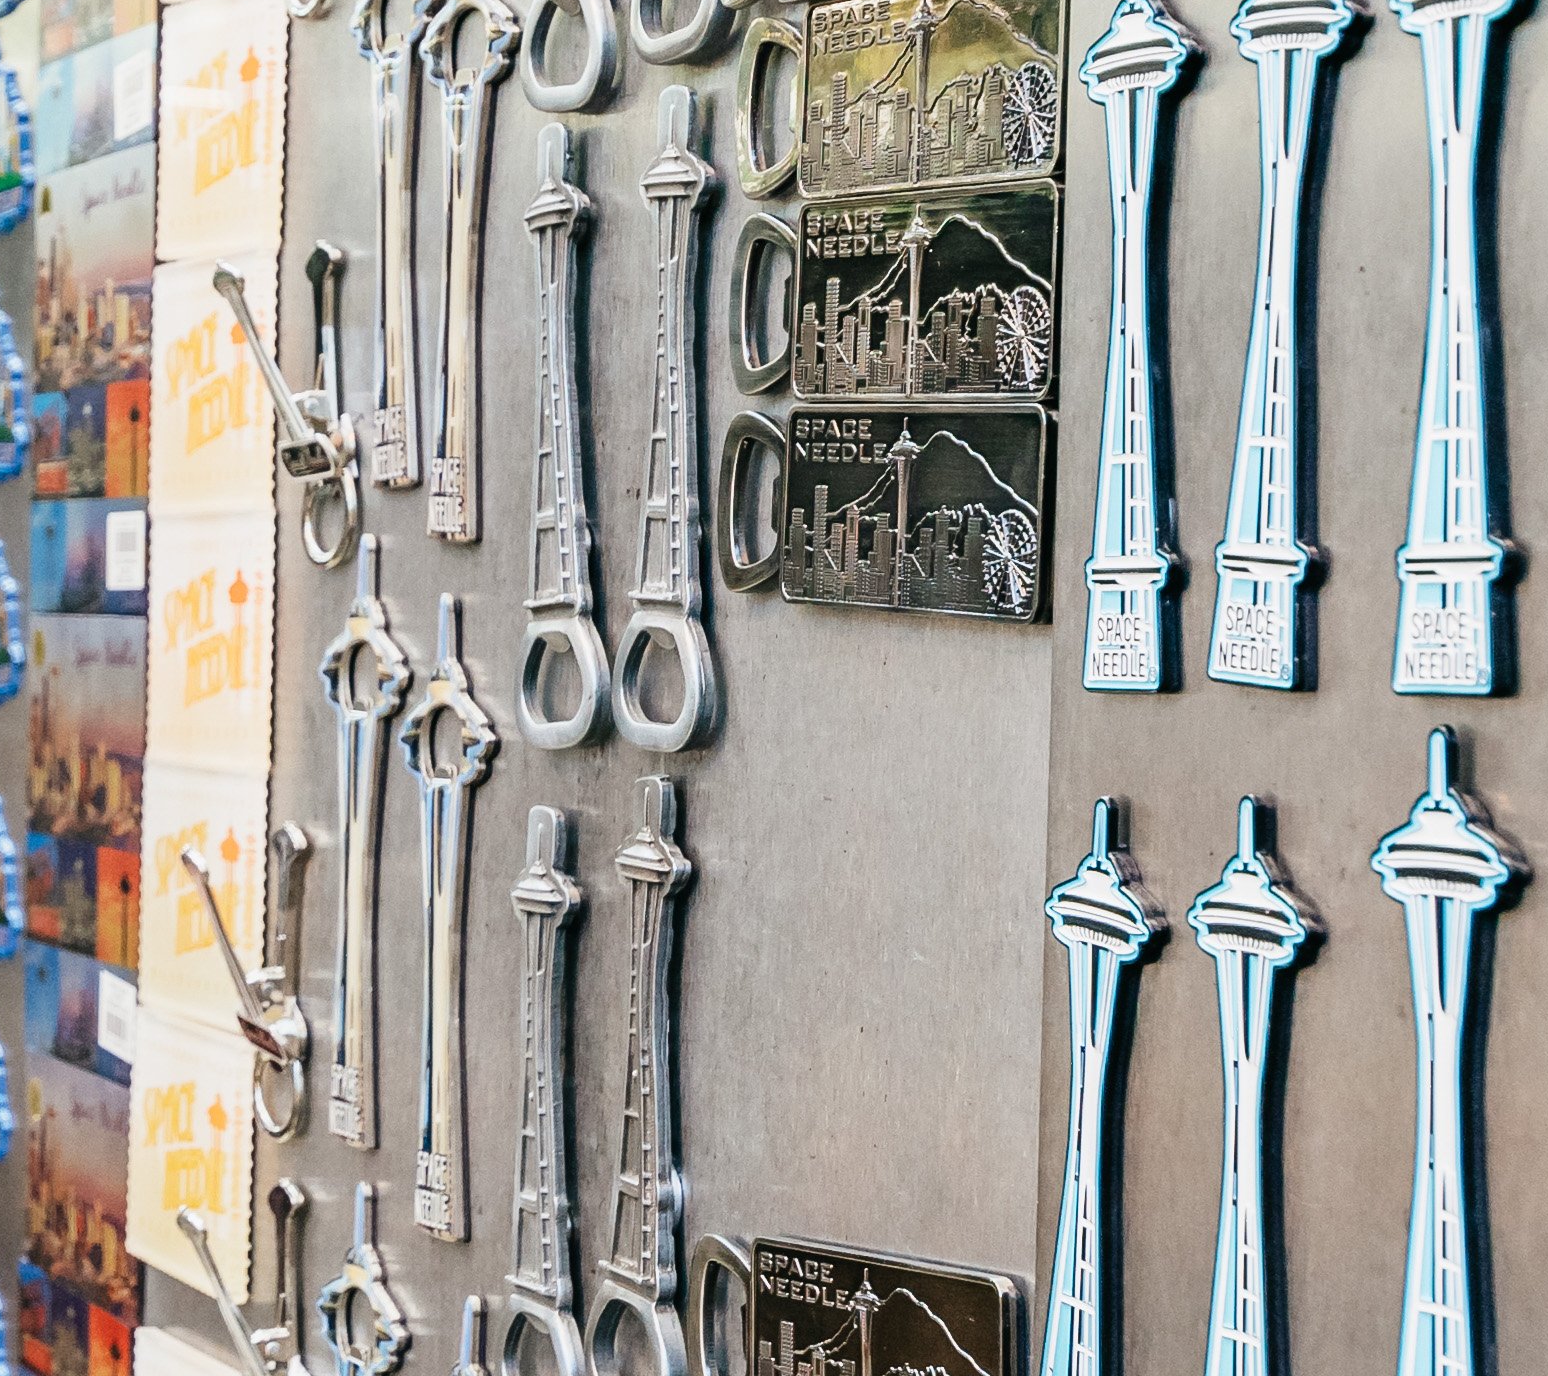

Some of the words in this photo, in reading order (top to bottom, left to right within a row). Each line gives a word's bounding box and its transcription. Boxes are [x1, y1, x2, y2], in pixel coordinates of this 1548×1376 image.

[811, 0, 891, 33] SPACE
[811, 21, 908, 58] NEEDLE
[806, 208, 886, 237] SPACE
[805, 232, 903, 260] NEEDLE
[795, 418, 872, 440] SPACE
[794, 442, 889, 464] NEEDLE
[1097, 616, 1141, 642] SPACE
[1226, 604, 1274, 635] SPACE
[1411, 612, 1468, 640] SPACE
[759, 1251, 834, 1284] SPACE
[758, 1274, 850, 1310] NEEDLE
